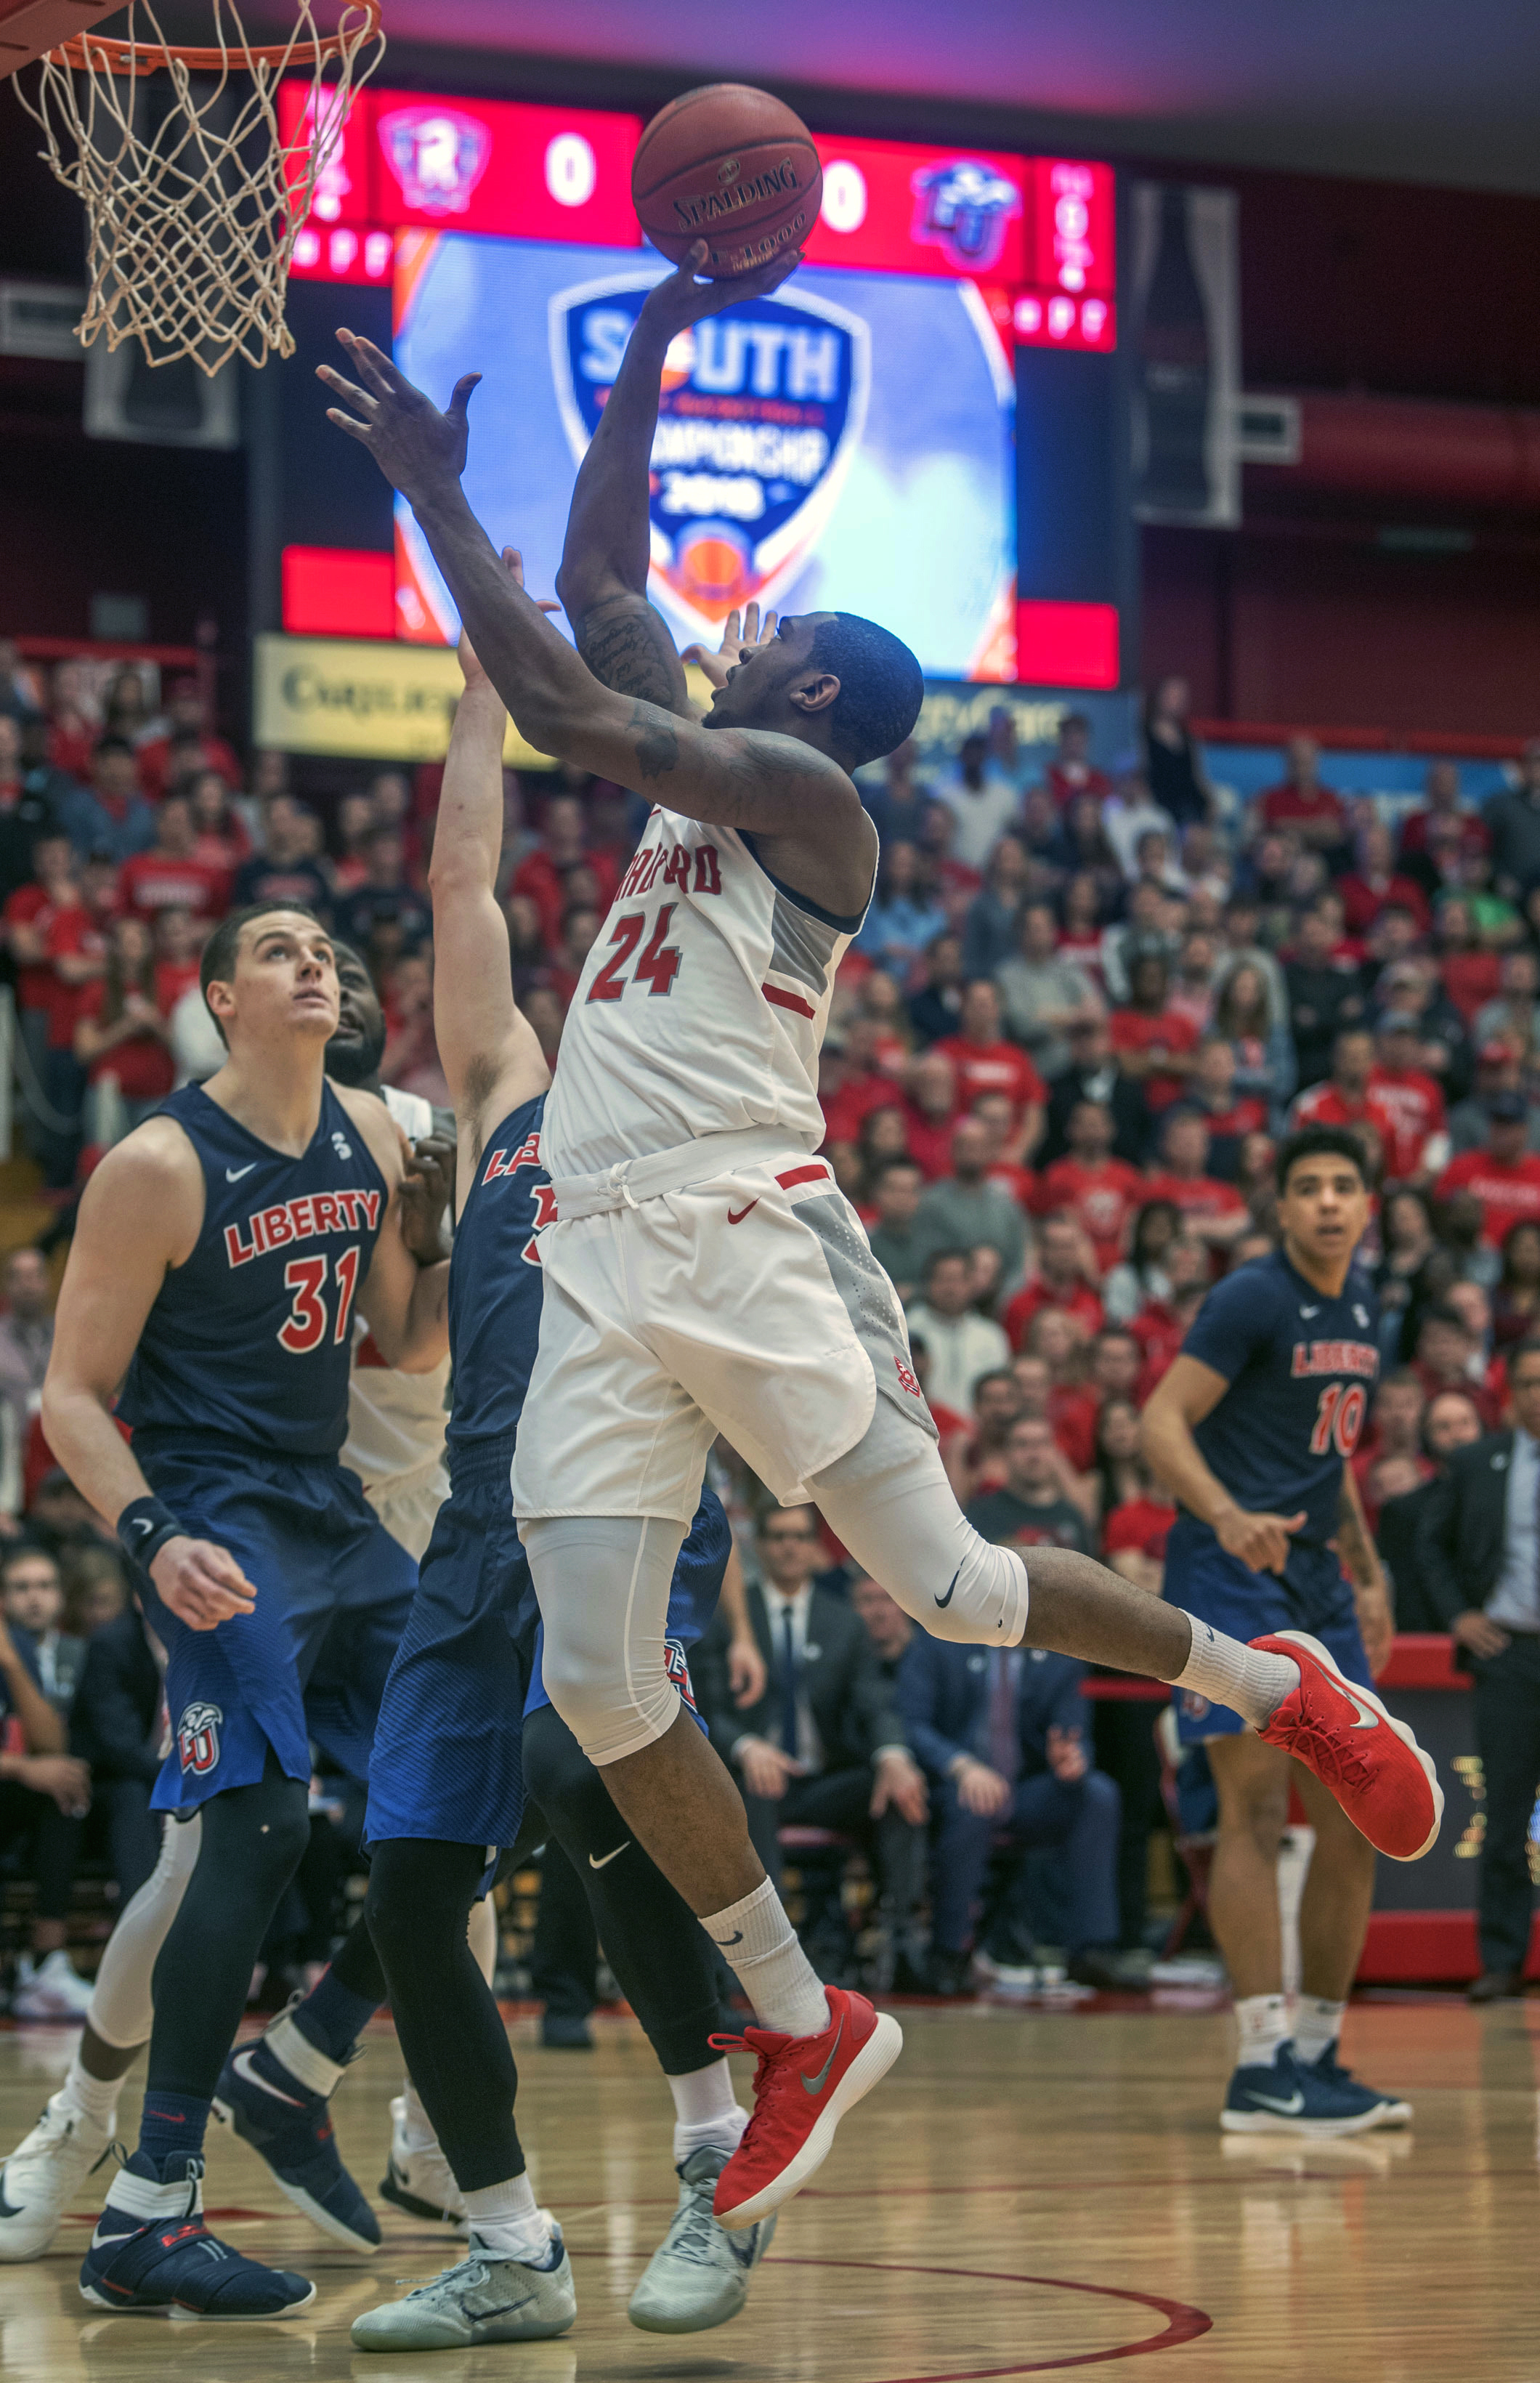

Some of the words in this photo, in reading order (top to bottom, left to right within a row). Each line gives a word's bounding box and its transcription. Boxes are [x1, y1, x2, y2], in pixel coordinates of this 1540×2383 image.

[543, 132, 597, 207] 0
[673, 157, 798, 232] SPALDING
[821, 158, 869, 234] 0
[585, 902, 683, 1005] 24
[224, 1189, 381, 1269] LIBERTY
[277, 1245, 361, 1354] 31
[1309, 1383, 1367, 1455] 10
